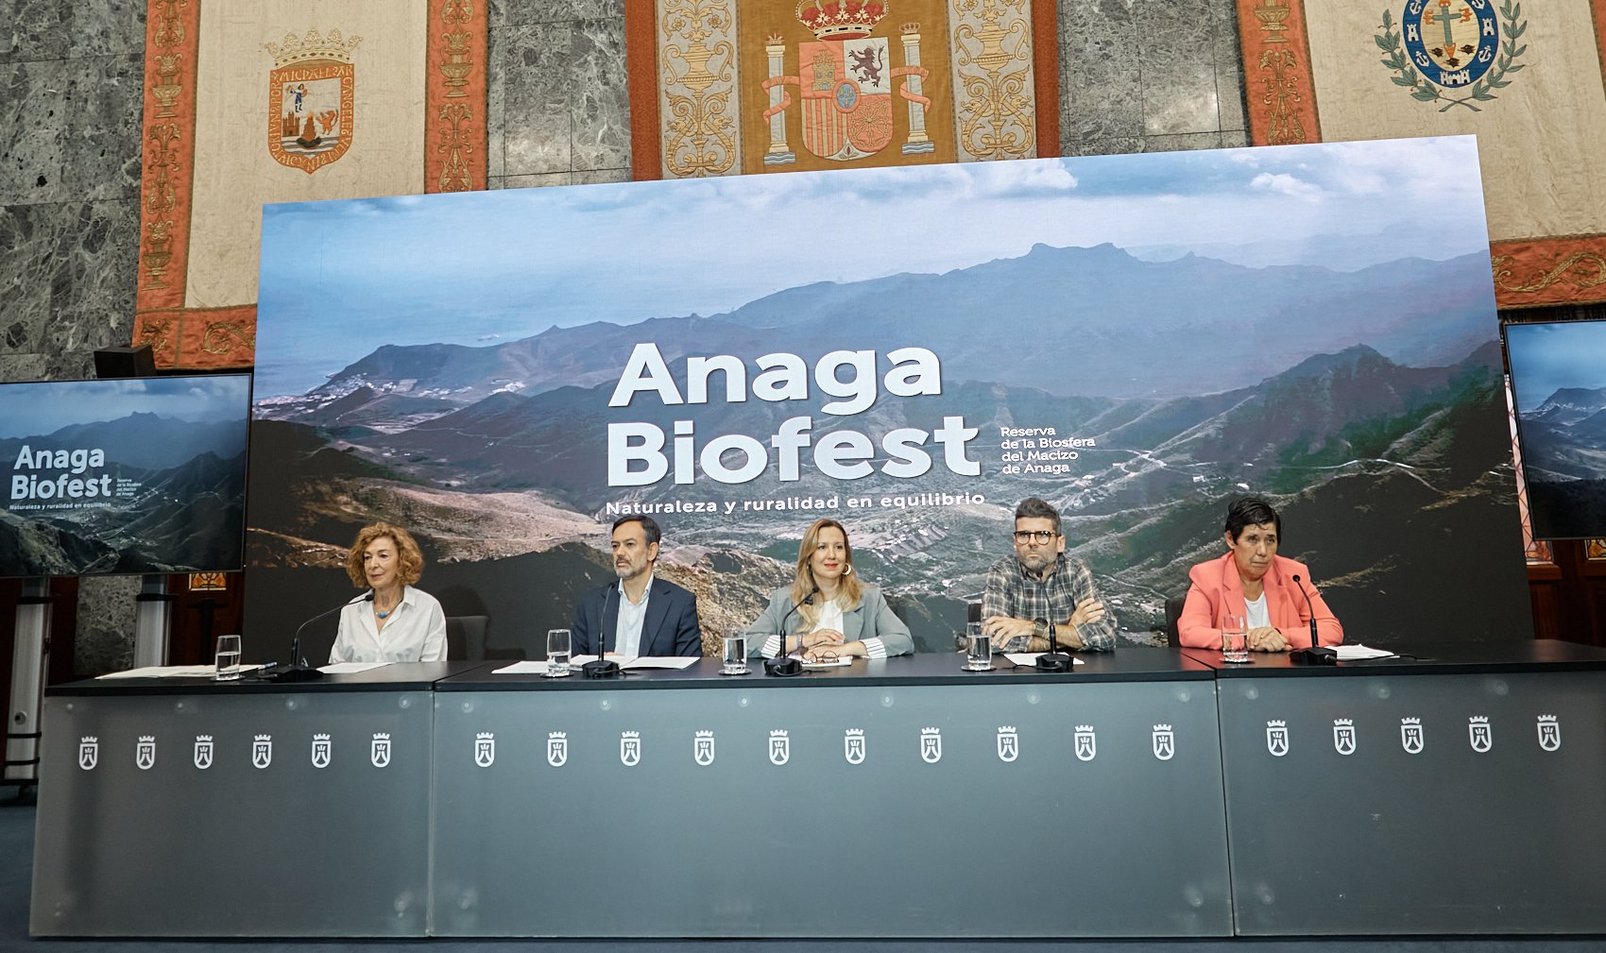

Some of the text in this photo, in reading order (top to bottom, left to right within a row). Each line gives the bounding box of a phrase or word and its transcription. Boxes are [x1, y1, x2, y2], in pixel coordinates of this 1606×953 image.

[608, 342, 942, 416] Anaga
[1000, 427, 1056, 437] Reserva
[1001, 437, 1096, 449] de la Biosfera
[13, 445, 105, 474] Anaga
[607, 416, 982, 487] Biofest
[1002, 450, 1079, 461] del Macizo
[1002, 463, 1071, 474] de Anaga
[10, 474, 112, 499] Biofest
[605, 492, 985, 515] Naturaleza y ruralidad en equilibrio
